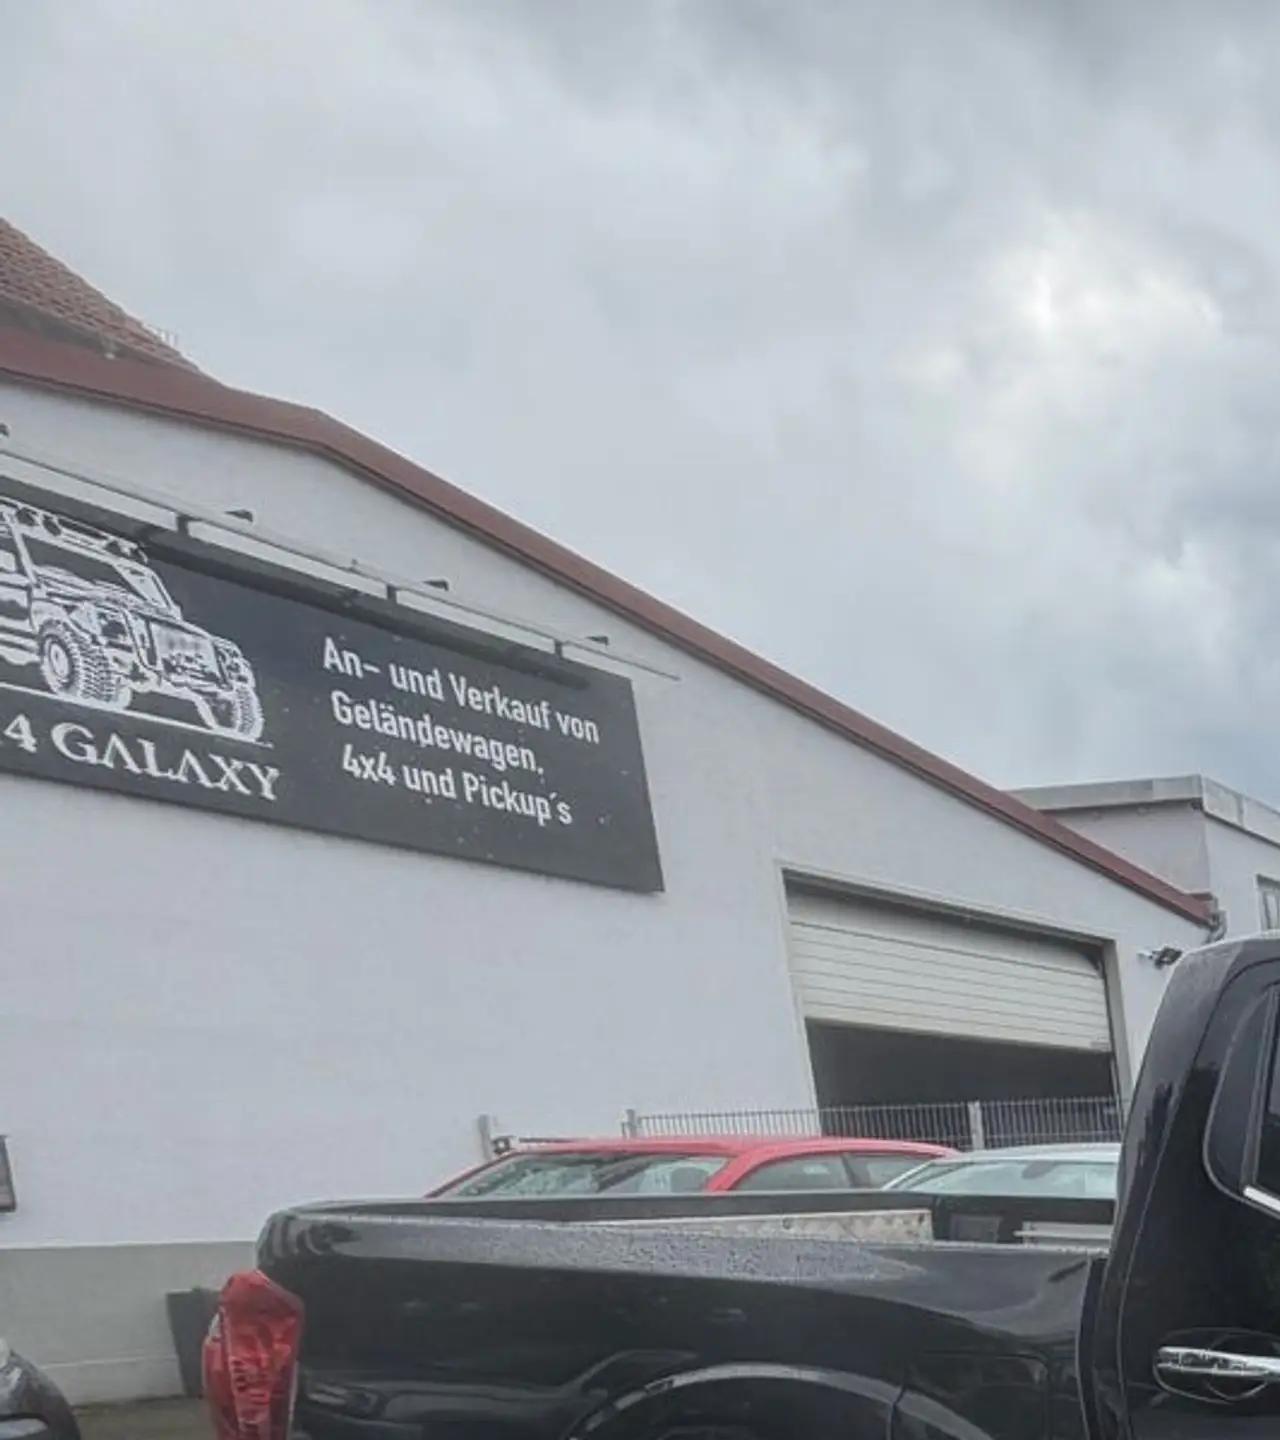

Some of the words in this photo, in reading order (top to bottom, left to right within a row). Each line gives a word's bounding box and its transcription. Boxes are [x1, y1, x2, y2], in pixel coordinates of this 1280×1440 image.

[323, 637, 381, 678] An-
[389, 664, 445, 701] und
[449, 671, 551, 730] Verkauf
[556, 711, 600, 744] von
[50, 722, 280, 801] GALAXY
[342, 744, 397, 786] 4x4
[403, 764, 457, 799] und
